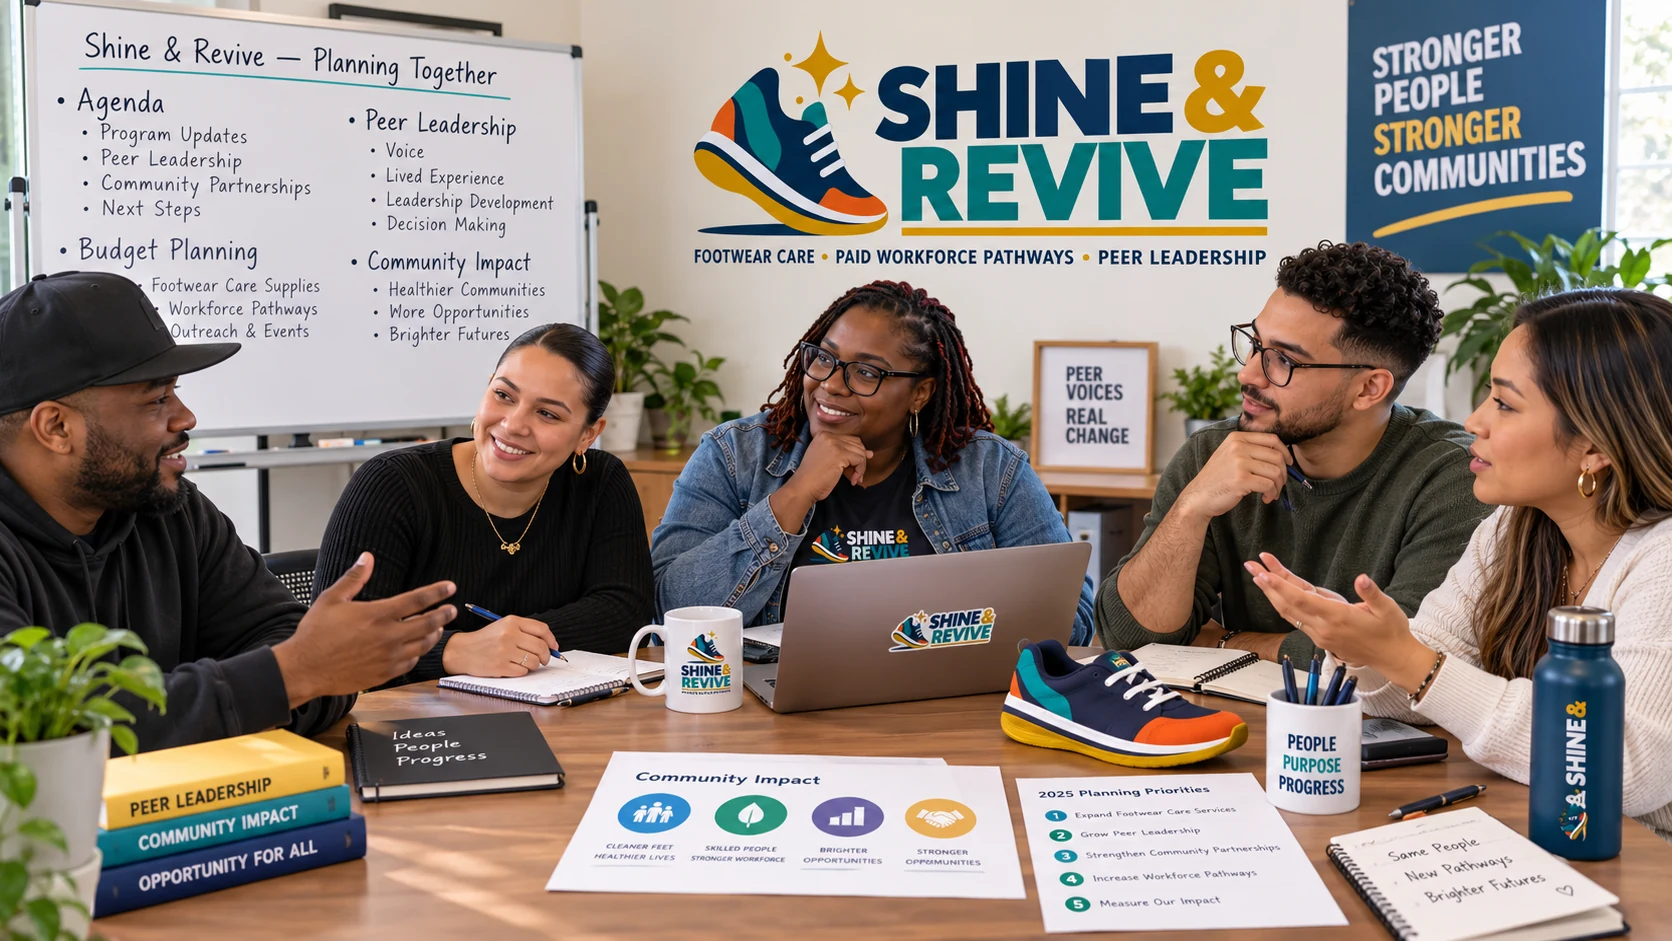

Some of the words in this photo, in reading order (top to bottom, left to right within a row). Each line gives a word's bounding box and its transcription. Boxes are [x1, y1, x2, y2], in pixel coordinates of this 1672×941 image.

[86, 32, 150, 60] Shine
[164, 36, 180, 62] &
[194, 38, 264, 66] Revive
[313, 47, 399, 86] Planning
[410, 57, 497, 90] Together
[1372, 22, 1522, 79] STRONGER
[1374, 67, 1484, 116] PEOPLE
[78, 88, 164, 121] Agenda
[101, 123, 170, 147] Program
[182, 126, 247, 149] Updates
[366, 109, 407, 130] Peer
[419, 112, 516, 144] Leadership
[1373, 105, 1522, 156] STRONGER
[386, 142, 424, 158] Voice
[102, 149, 139, 165] Peer
[150, 151, 241, 174] Leadership
[1374, 141, 1587, 197] COMMUNITIES
[102, 174, 199, 199] Community
[210, 176, 310, 200] Partnerships
[387, 168, 421, 183] Lived
[431, 168, 504, 189] Experience
[902, 138, 1268, 221] REVIVE
[103, 199, 143, 216] Next
[155, 200, 200, 222] Steps
[387, 191, 462, 213] Leadership
[471, 194, 553, 215] Development
[388, 215, 446, 230] Decision
[455, 217, 505, 238] Making
[79, 237, 158, 269] Budget
[171, 238, 256, 270] Planning
[695, 249, 771, 263] FOOTWEAR
[777, 249, 814, 263] CARE
[837, 250, 871, 263] PAID
[877, 250, 976, 264] WORKFORCE
[984, 250, 1073, 264] PATHWAYS
[1099, 250, 1142, 264] PEER
[1151, 250, 1266, 265] LEADERSHIP
[369, 251, 465, 278] Community
[477, 252, 531, 278] Impact
[153, 277, 218, 292] Footwear
[226, 278, 257, 292] Care
[265, 278, 320, 298] Supplies
[390, 282, 453, 296] Healthier
[461, 282, 545, 296] Communities
[169, 300, 243, 315] Workforce
[253, 301, 317, 321] Pathways
[434, 304, 529, 324] Opportunities
[170, 323, 238, 339] Outreach
[246, 323, 255, 338] &
[265, 323, 309, 337] Events
[390, 326, 450, 347] Brighter
[459, 326, 509, 341] Futures
[1067, 366, 1102, 381] PEER
[1066, 384, 1123, 400] VOICES
[1067, 408, 1107, 425] REAL
[1066, 427, 1129, 444] CHANGE
[851, 544, 909, 560] REVIVE
[931, 624, 992, 644] REVIVE
[681, 675, 731, 688] REVIVE
[392, 729, 446, 741] Ideas
[1288, 734, 1336, 751] PEOPLE
[393, 739, 461, 753] People
[397, 753, 486, 766] Progress
[1284, 755, 1341, 773] PURPOSE
[636, 772, 747, 785] Community
[754, 774, 821, 787] Impact
[1280, 775, 1344, 795] PROGRESS
[131, 797, 169, 817] PEER
[177, 778, 271, 808] LEADERSHIP
[1038, 790, 1074, 799] 2025
[1078, 788, 1141, 798] Planning
[1144, 786, 1210, 795] Priorities
[1051, 811, 1060, 820] 1
[1074, 811, 1113, 820] Expand
[139, 817, 236, 850] COMMUNITY
[242, 805, 298, 829] IMPACT
[1056, 831, 1067, 841] 2
[1141, 827, 1201, 836] Leadership
[1061, 851, 1072, 862] 3
[1085, 850, 1146, 861] Strengthen
[1149, 847, 1209, 857] Community
[1212, 844, 1281, 853] Partnerships
[1387, 849, 1429, 862] Same
[1432, 838, 1479, 852] People
[139, 854, 247, 891] OPPORTUNITY
[254, 847, 284, 866] FOR
[290, 840, 317, 858] ALL
[1404, 868, 1438, 882] New
[1442, 857, 1512, 874] Pathways
[1065, 874, 1078, 885] 4
[1092, 874, 1140, 883] Increase
[1142, 871, 1201, 881] Workforce
[1203, 869, 1258, 879] Pathways
[1424, 886, 1484, 903] Brighter
[1489, 875, 1545, 890] Futures
[1072, 899, 1085, 910] 5
[1099, 899, 1149, 908] Measure
[1153, 897, 1176, 906] Our
[1179, 896, 1221, 907] Impact
